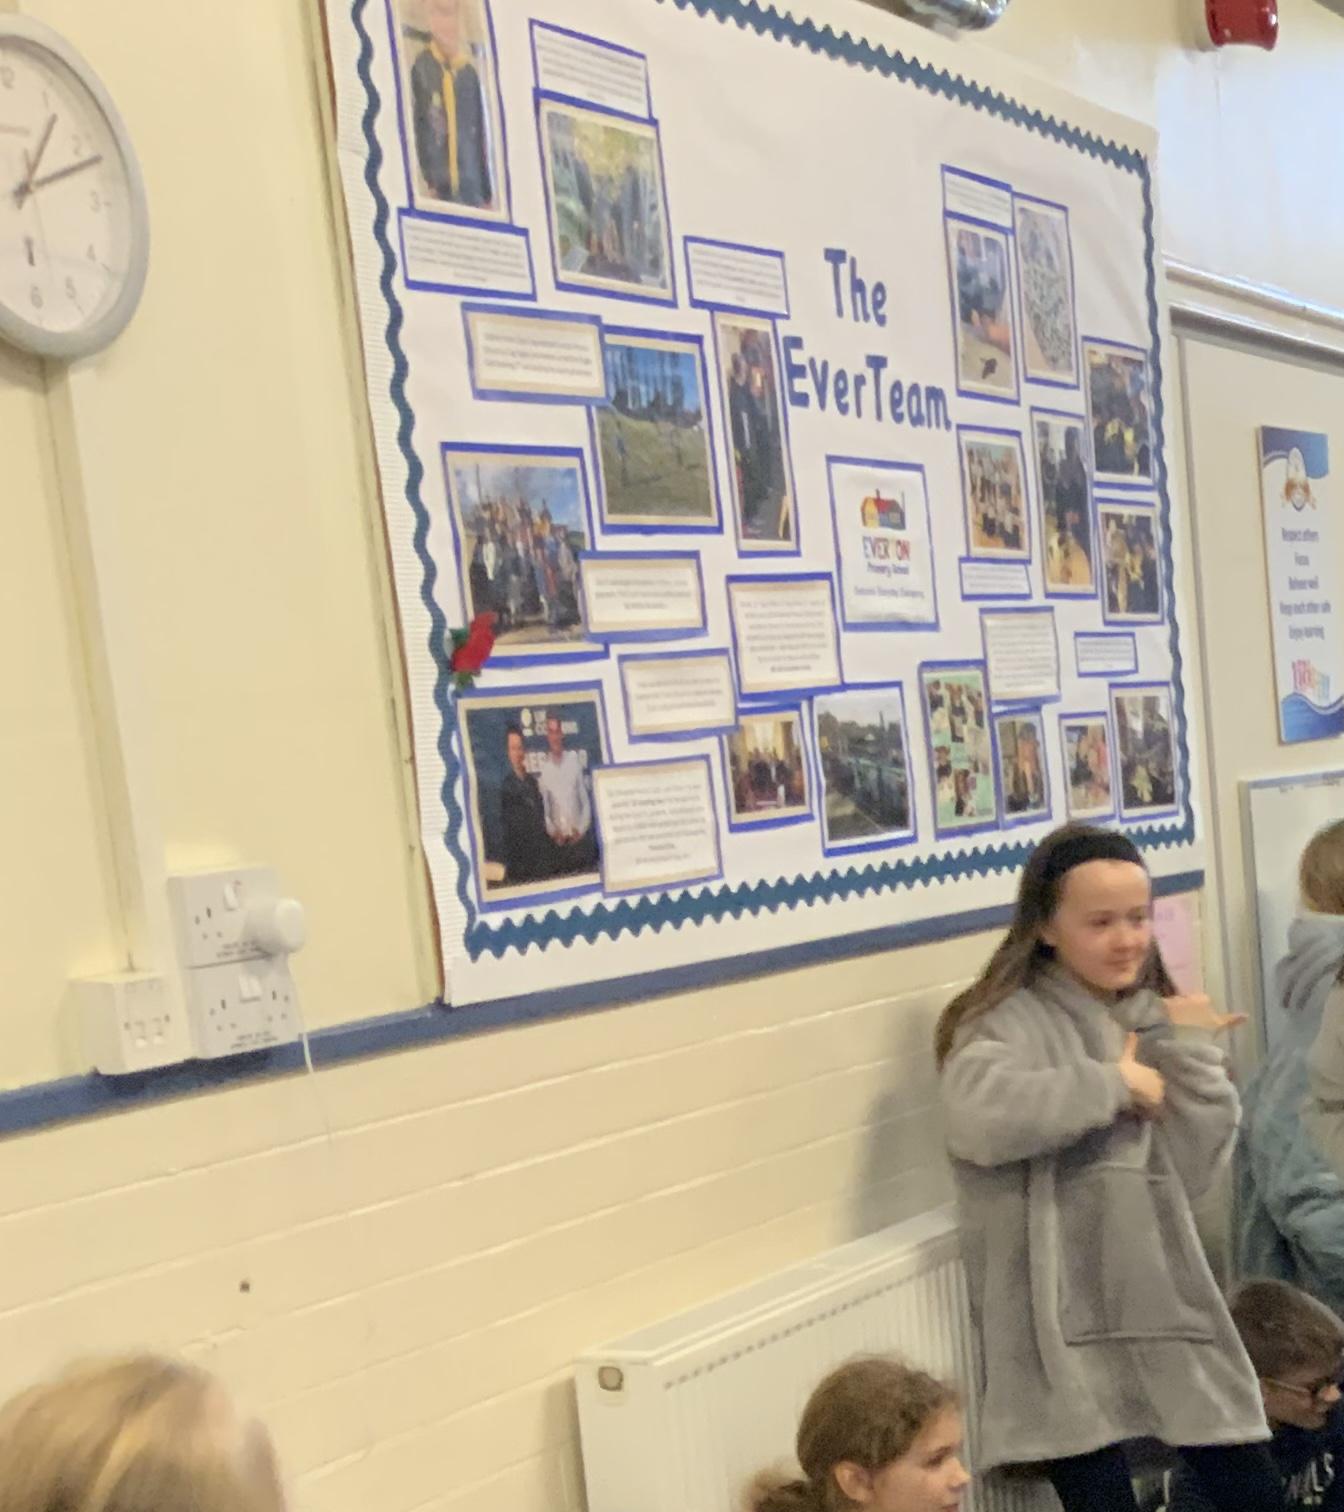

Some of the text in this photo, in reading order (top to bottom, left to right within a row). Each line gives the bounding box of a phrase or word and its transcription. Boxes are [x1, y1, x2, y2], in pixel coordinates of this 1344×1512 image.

[30, 285, 44, 310] 6
[823, 247, 887, 328] The
[782, 335, 952, 432] EverTeam
